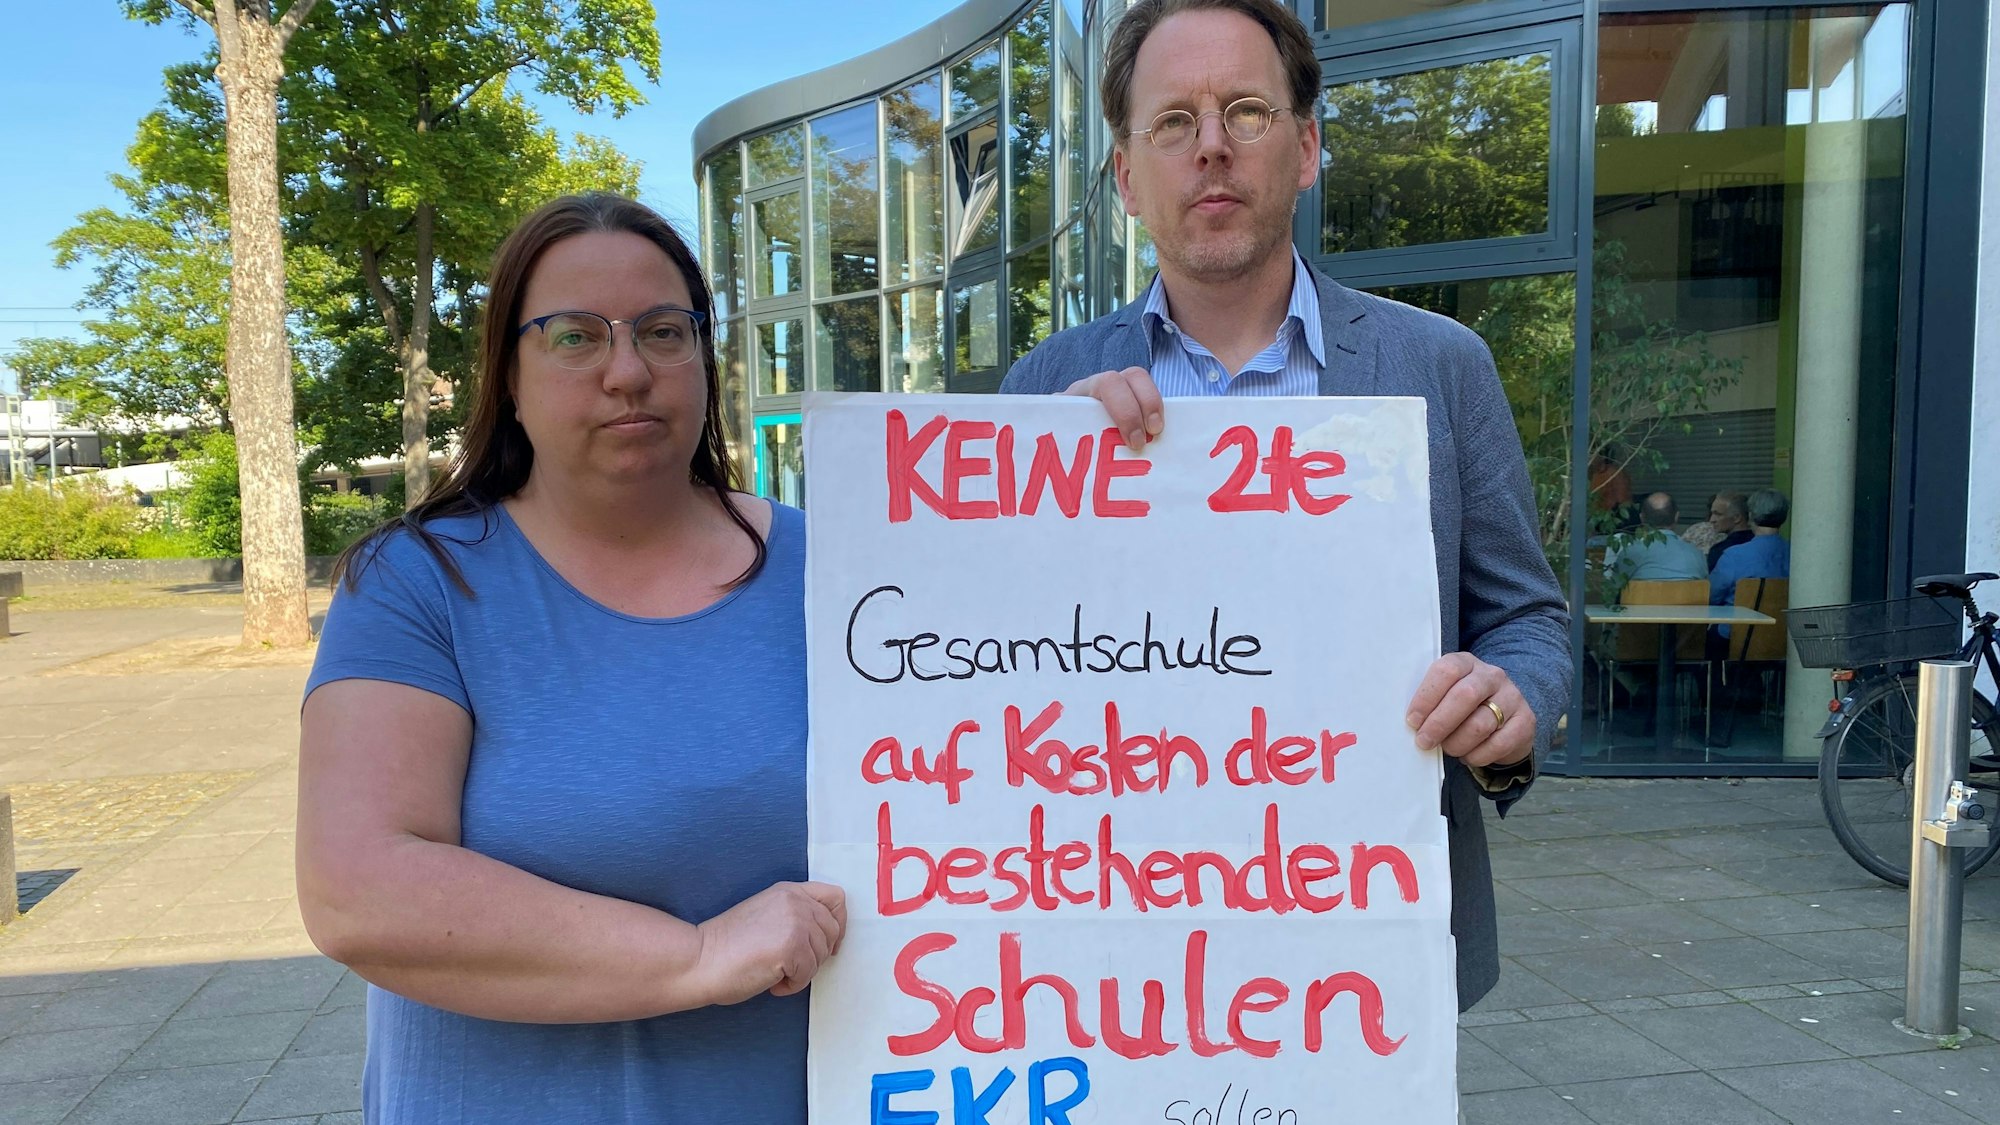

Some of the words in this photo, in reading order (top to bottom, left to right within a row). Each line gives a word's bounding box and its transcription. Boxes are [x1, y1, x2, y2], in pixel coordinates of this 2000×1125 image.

[886, 409, 1153, 523] KEINE
[1207, 425, 1352, 515] 2te
[846, 585, 1273, 684] Gesamtschule
[861, 720, 980, 804] auf
[1004, 701, 1209, 797] Kosten
[1225, 706, 1357, 786] der
[877, 802, 1420, 916] bestehenden
[887, 930, 1407, 1060] Schulen
